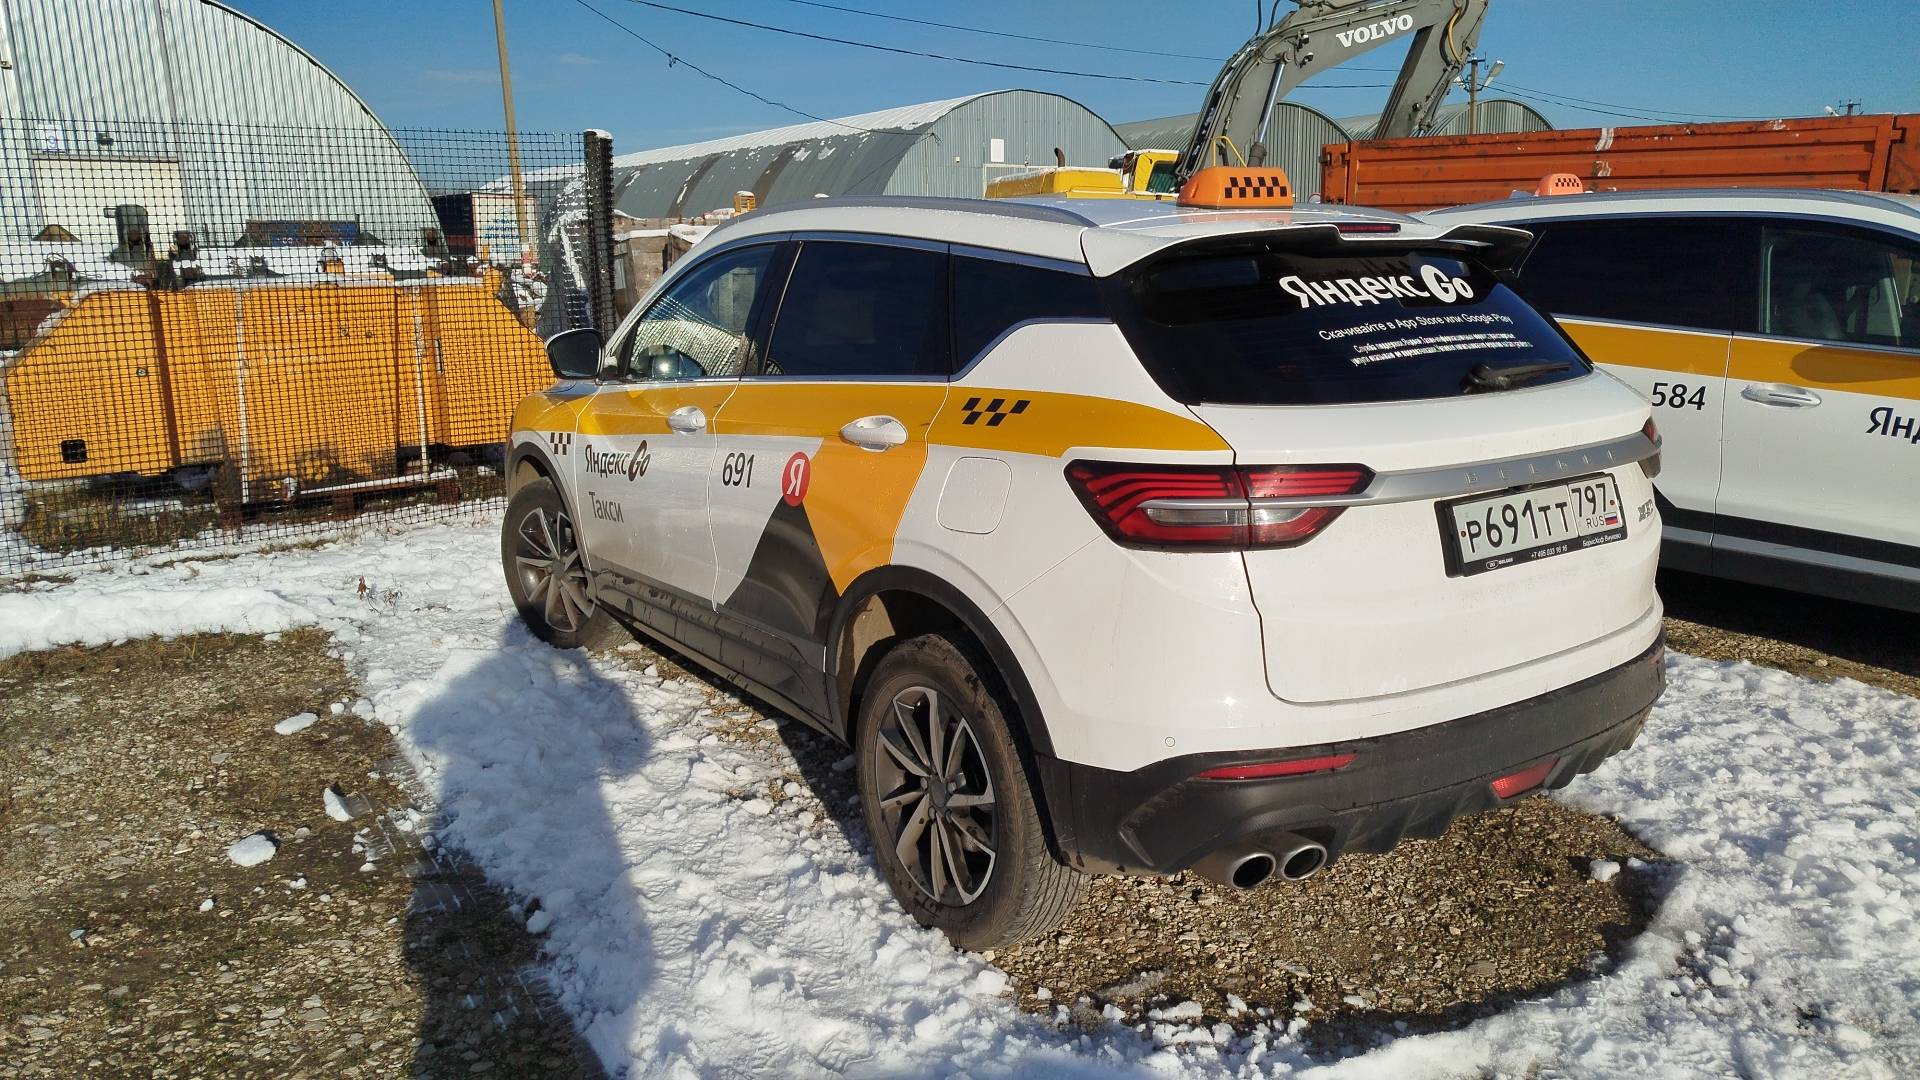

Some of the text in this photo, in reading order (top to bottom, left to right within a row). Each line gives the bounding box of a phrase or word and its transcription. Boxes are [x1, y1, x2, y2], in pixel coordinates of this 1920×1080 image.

[1336, 14, 1414, 48] VOLVO
[1279, 264, 1475, 309] Яндекс Go
[1318, 313, 1514, 341] Скачивайте в App Store или Google Play
[1651, 381, 1707, 411] 584
[584, 439, 651, 482] Яндекс Go
[722, 452, 755, 488] 691
[786, 458, 806, 497] Я
[587, 491, 625, 524] Такси
[1571, 482, 1607, 518] 797
[1586, 514, 1605, 529] RUS
